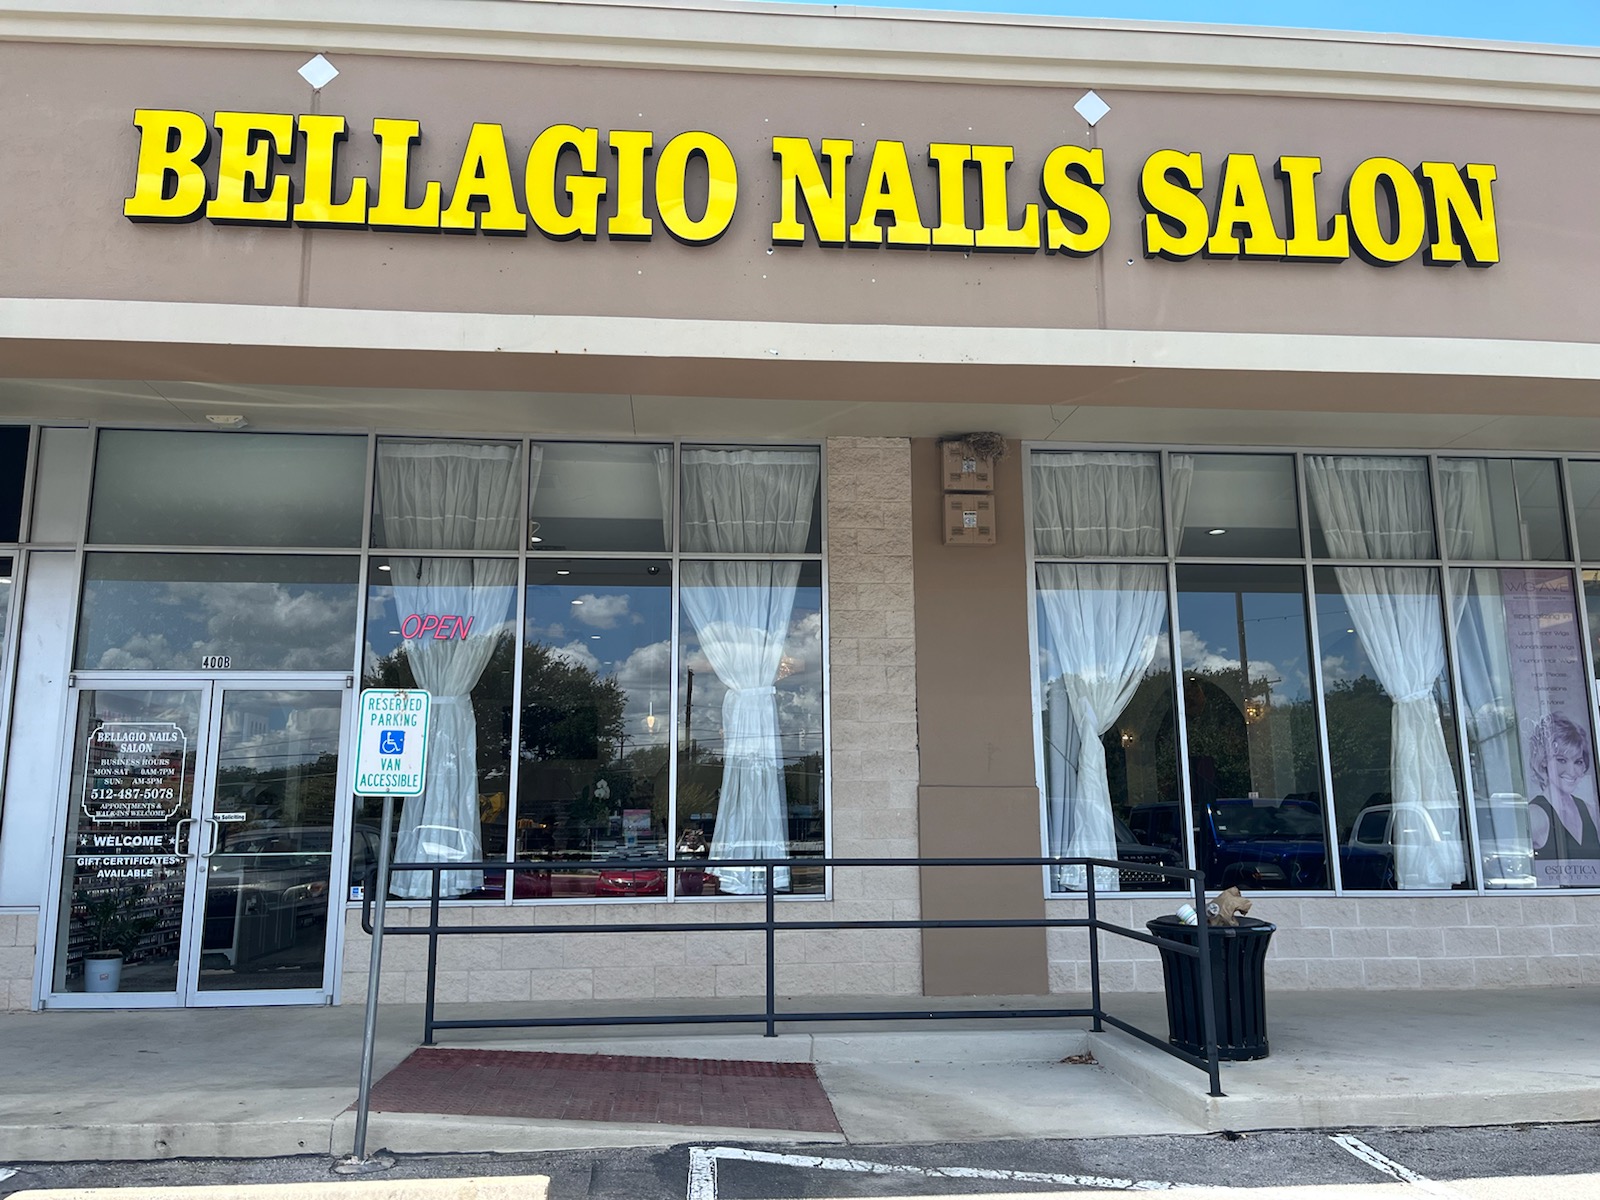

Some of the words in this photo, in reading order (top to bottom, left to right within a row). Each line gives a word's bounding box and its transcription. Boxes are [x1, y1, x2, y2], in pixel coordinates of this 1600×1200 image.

[124, 109, 738, 244] BELLAGIO
[772, 136, 1112, 252] NAILS
[1140, 149, 1499, 263] SALON
[1505, 582, 1536, 593] WIG
[1539, 582, 1569, 593] AVE
[401, 614, 474, 640] OPEN
[203, 656, 230, 669] 400B
[369, 698, 422, 711] RESERVED
[371, 713, 417, 726] PARKING
[97, 732, 147, 742] BELLAGIO
[148, 732, 178, 742] NAILS
[120, 743, 153, 753] SALON
[101, 758, 140, 766] BUSINESS
[141, 758, 170, 766] HOURS
[381, 758, 401, 771] VAN
[360, 774, 418, 787] ACCESSIBLE
[91, 788, 173, 800] 512-487-5078
[94, 835, 163, 847] WELCOME
[77, 857, 101, 867] GIFT
[103, 856, 176, 866] CERTIFICATES
[97, 869, 153, 878] AVAILABLE
